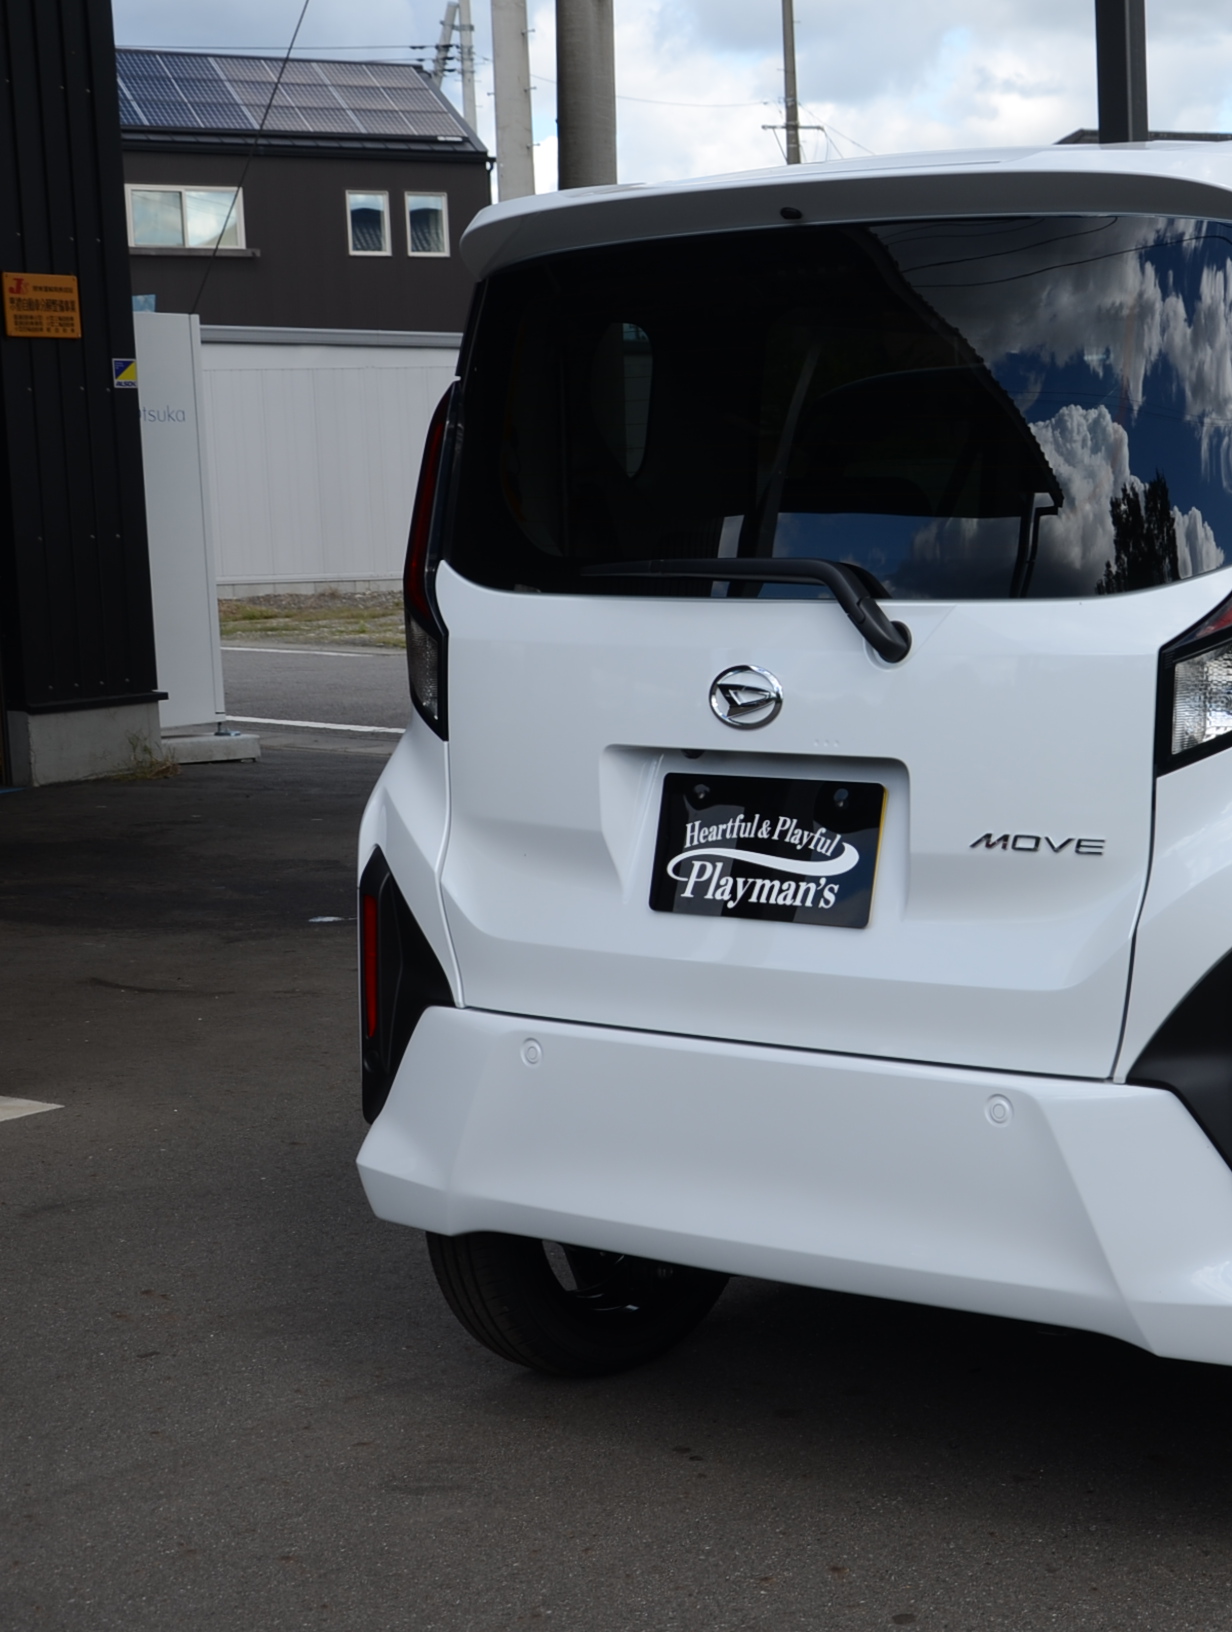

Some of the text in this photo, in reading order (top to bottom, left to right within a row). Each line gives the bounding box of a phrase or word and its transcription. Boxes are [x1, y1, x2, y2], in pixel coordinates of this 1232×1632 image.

[684, 813, 842, 856] Heartful & Playful
[969, 832, 1106, 856] MOVE
[680, 860, 840, 909] Playman's
